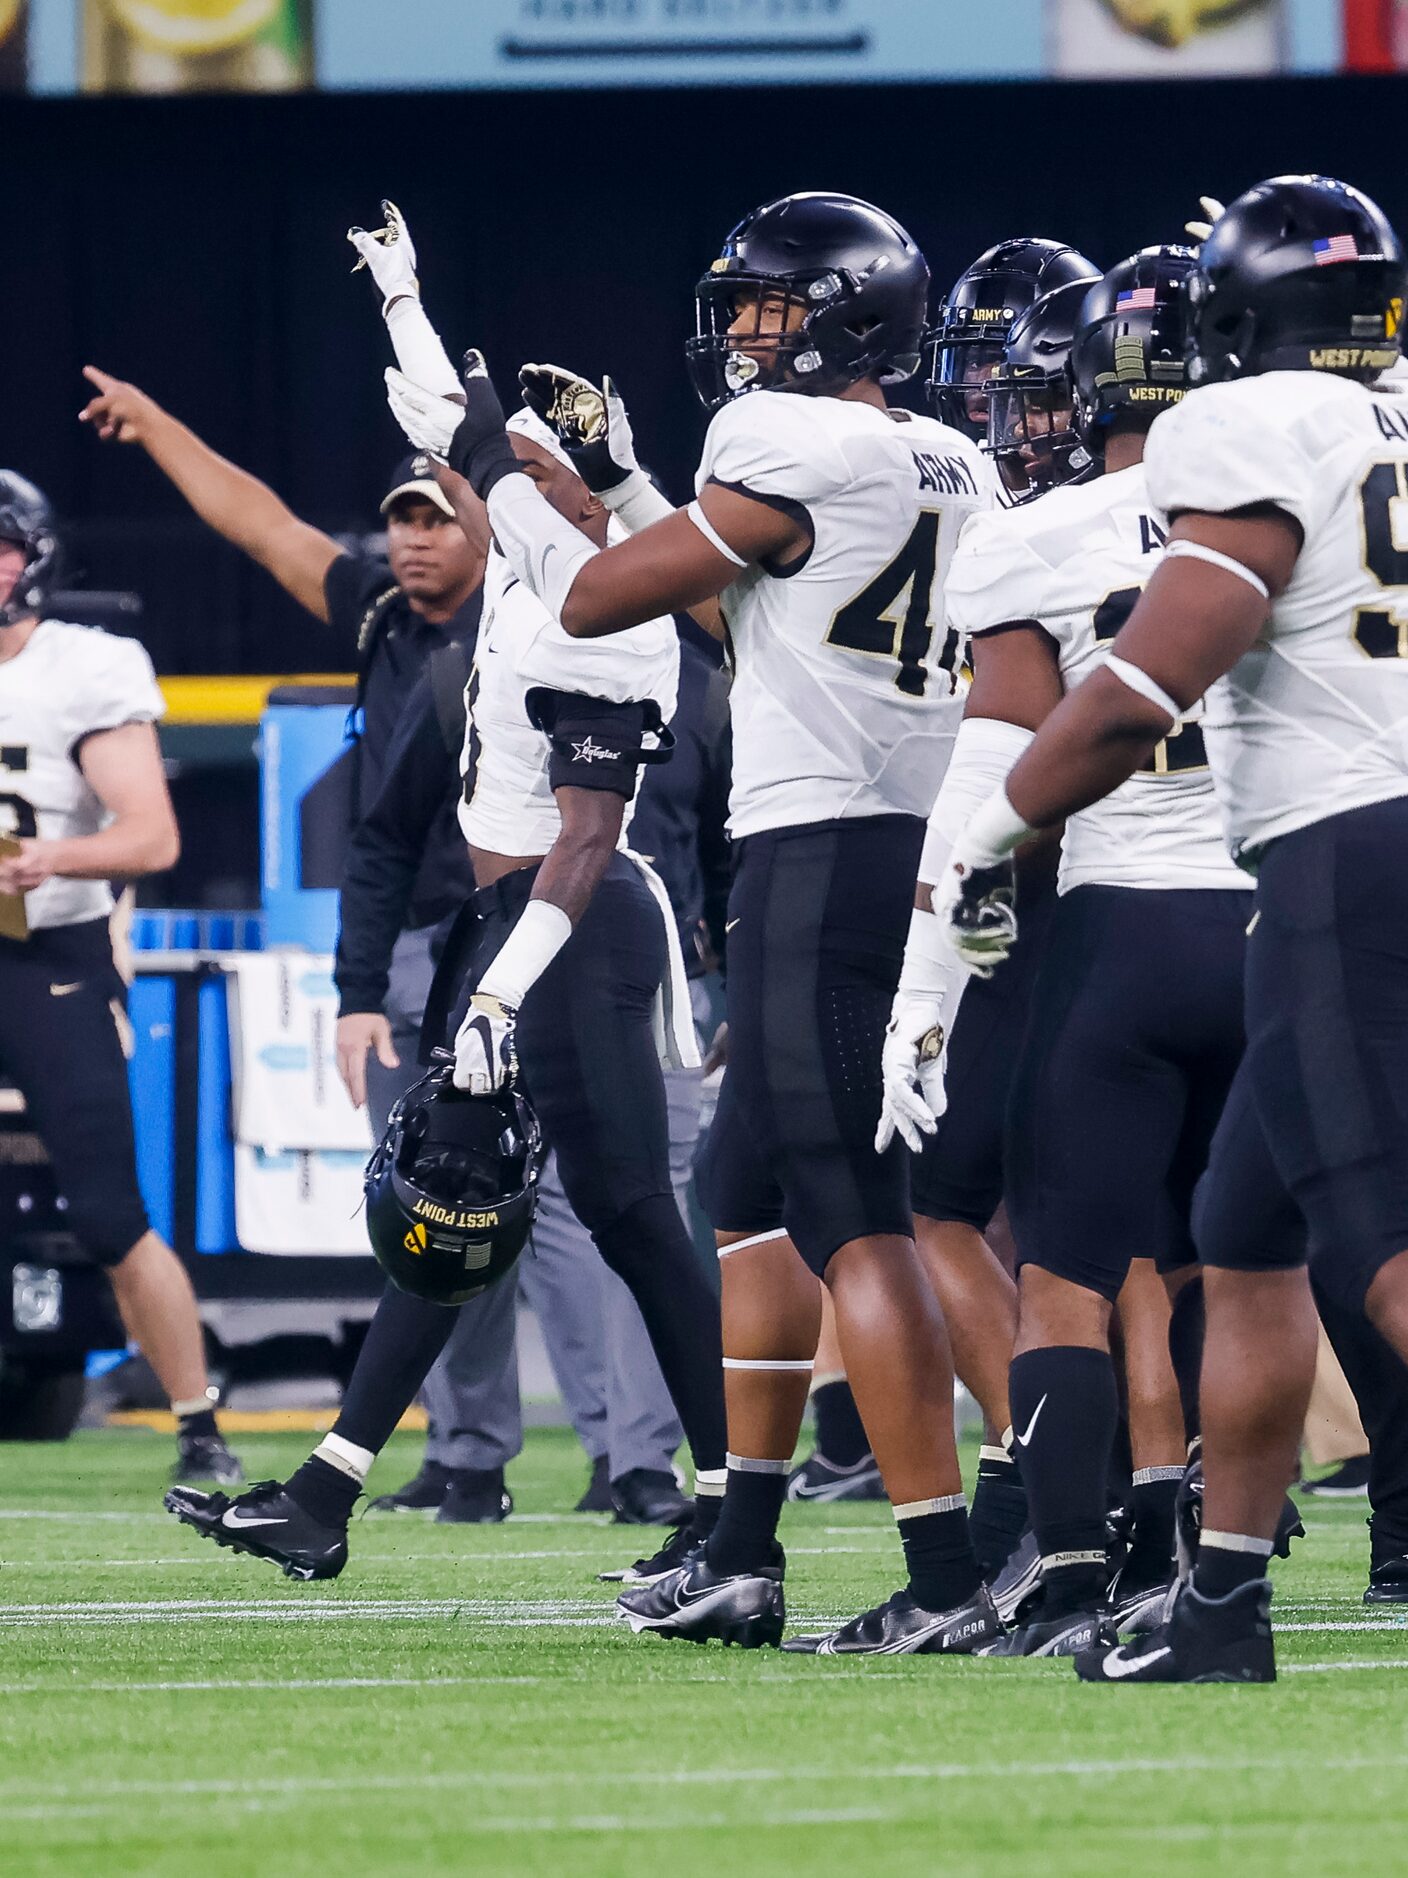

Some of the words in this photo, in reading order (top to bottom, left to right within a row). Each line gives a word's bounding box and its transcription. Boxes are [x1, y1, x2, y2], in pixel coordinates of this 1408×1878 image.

[972, 308, 1002, 321] ARMY
[1309, 348, 1362, 368] WEST
[1129, 387, 1164, 401] WEST
[911, 449, 979, 496] ARMY
[581, 746, 618, 760] Douglas
[411, 1198, 457, 1226] POINT
[456, 1210, 499, 1229] WEST
[1055, 1552, 1089, 1562] NIKE
